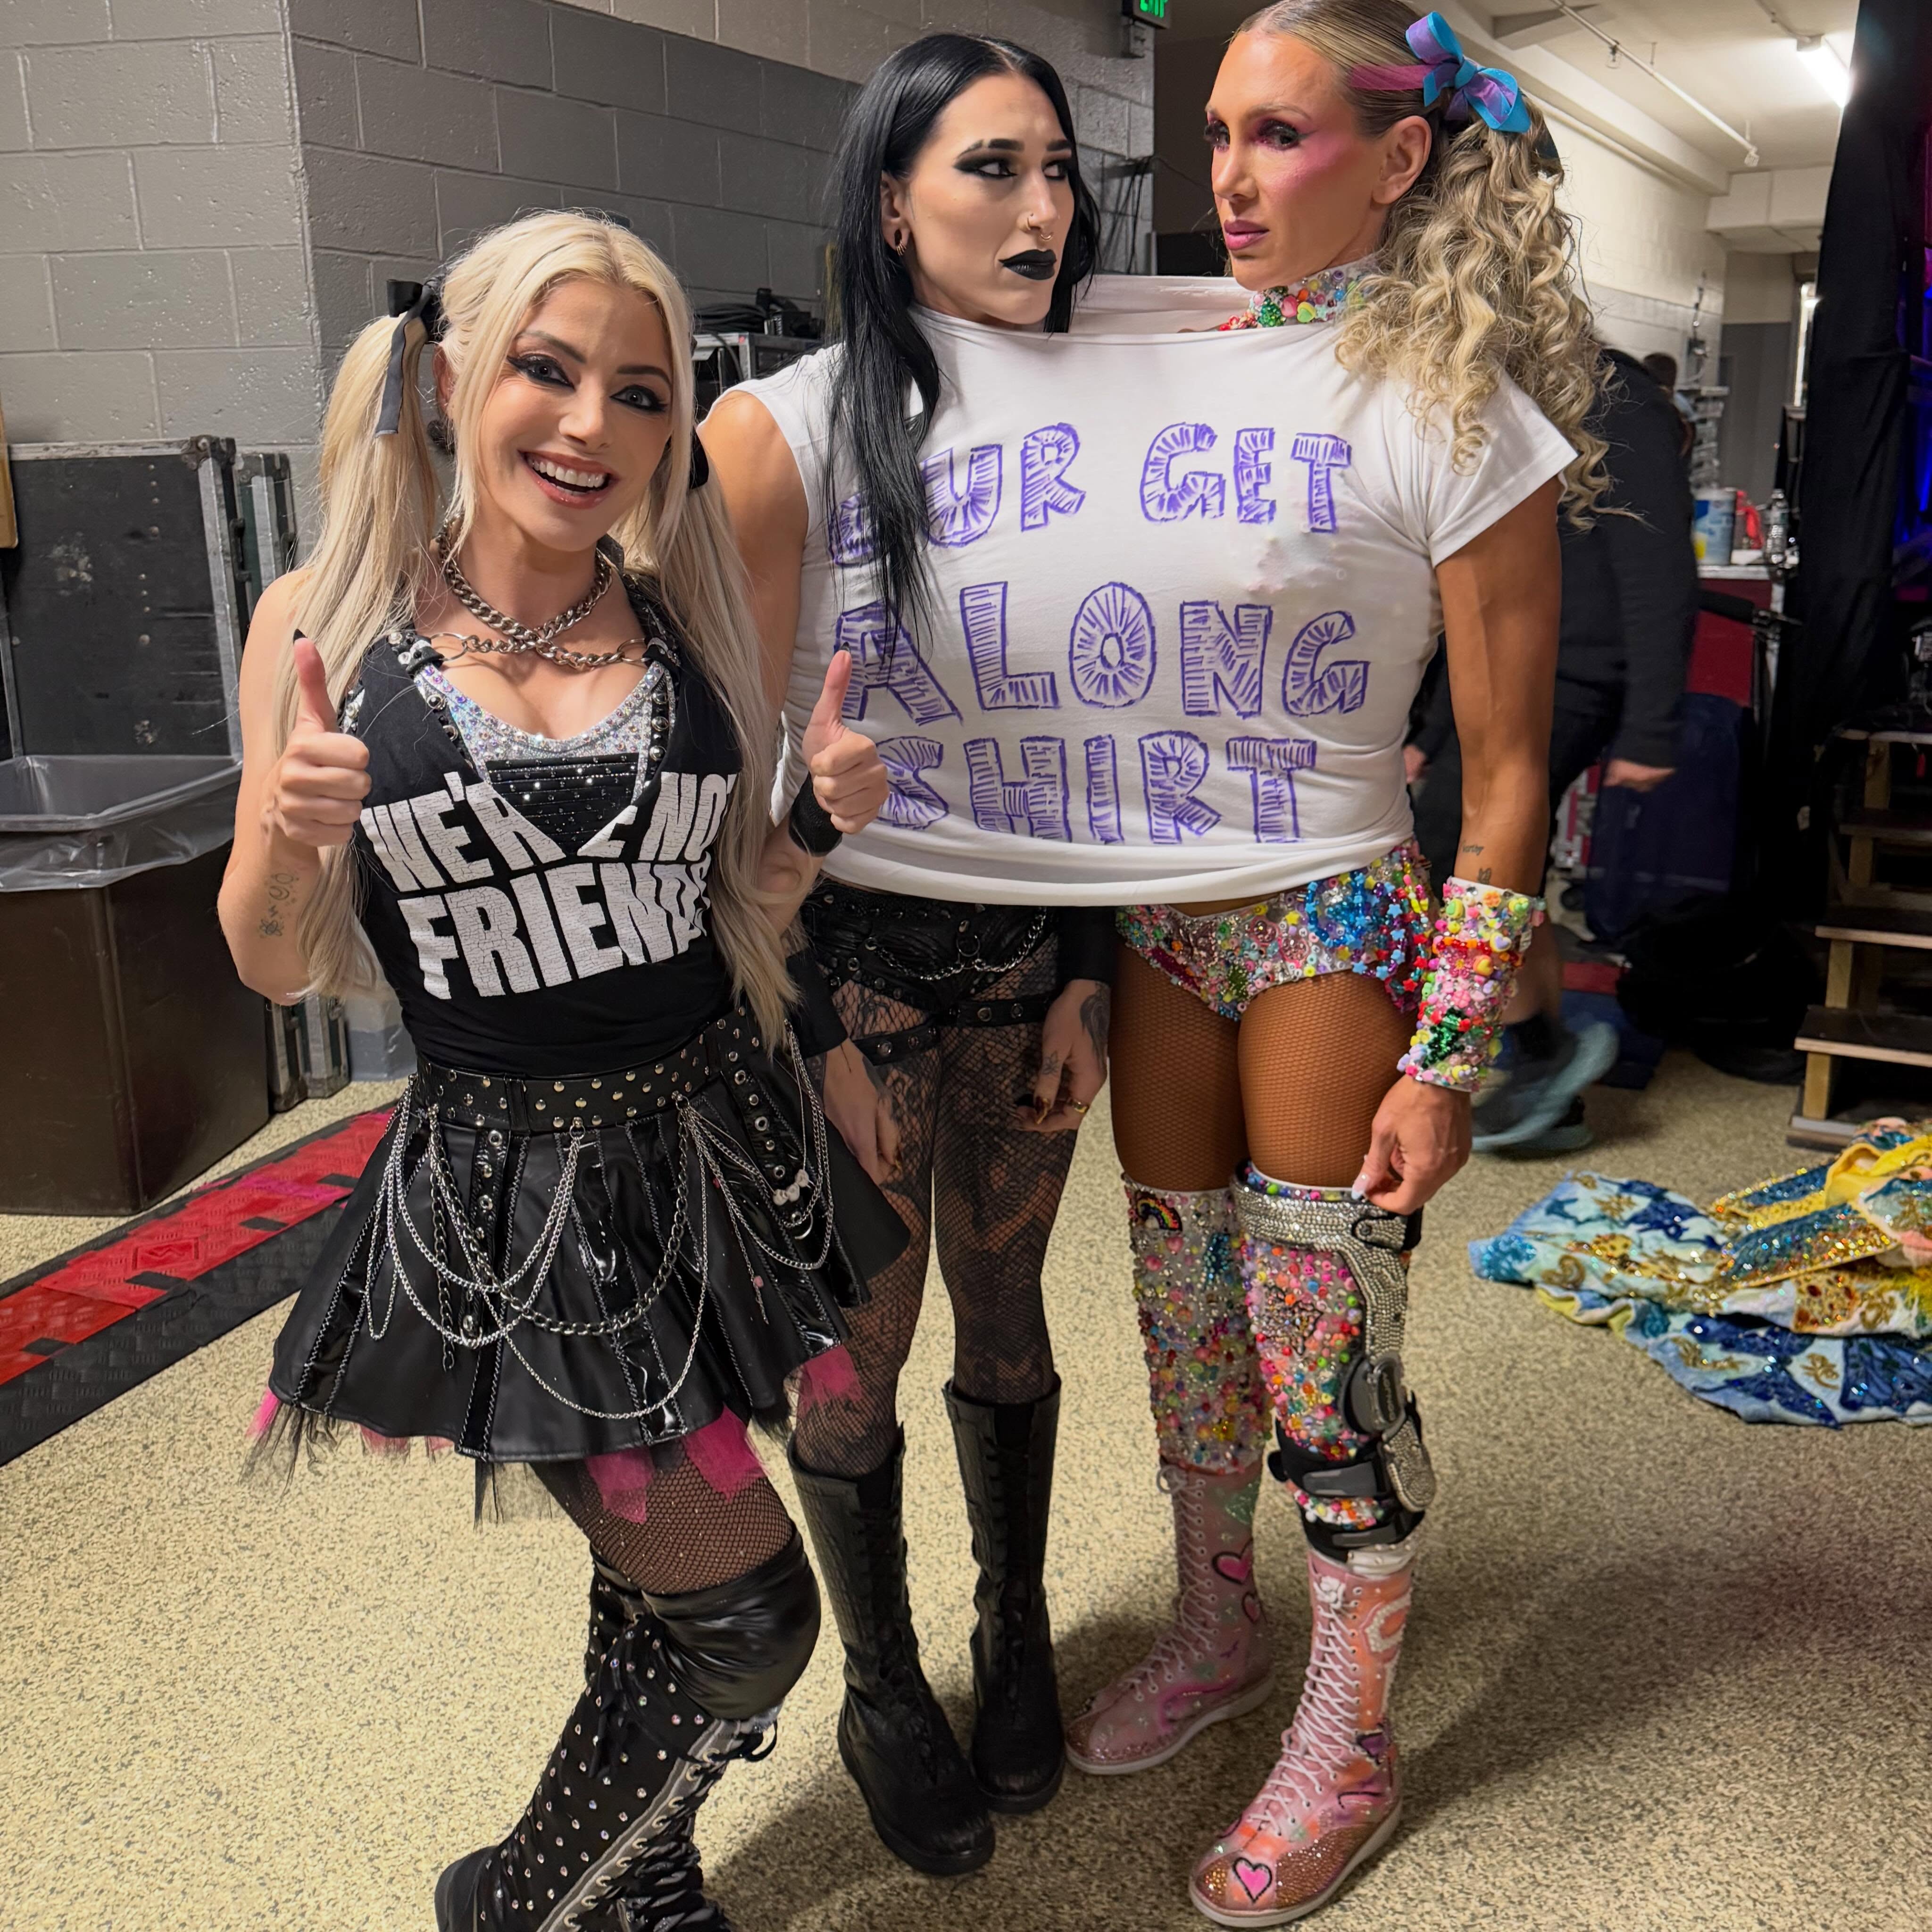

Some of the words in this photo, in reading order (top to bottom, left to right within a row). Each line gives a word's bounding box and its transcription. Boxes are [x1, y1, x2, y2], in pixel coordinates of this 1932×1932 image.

[1140, 422, 1351, 533] GET
[833, 582, 1370, 725] ALONG
[639, 771, 737, 861] NO
[875, 730, 1316, 845] SHIRT
